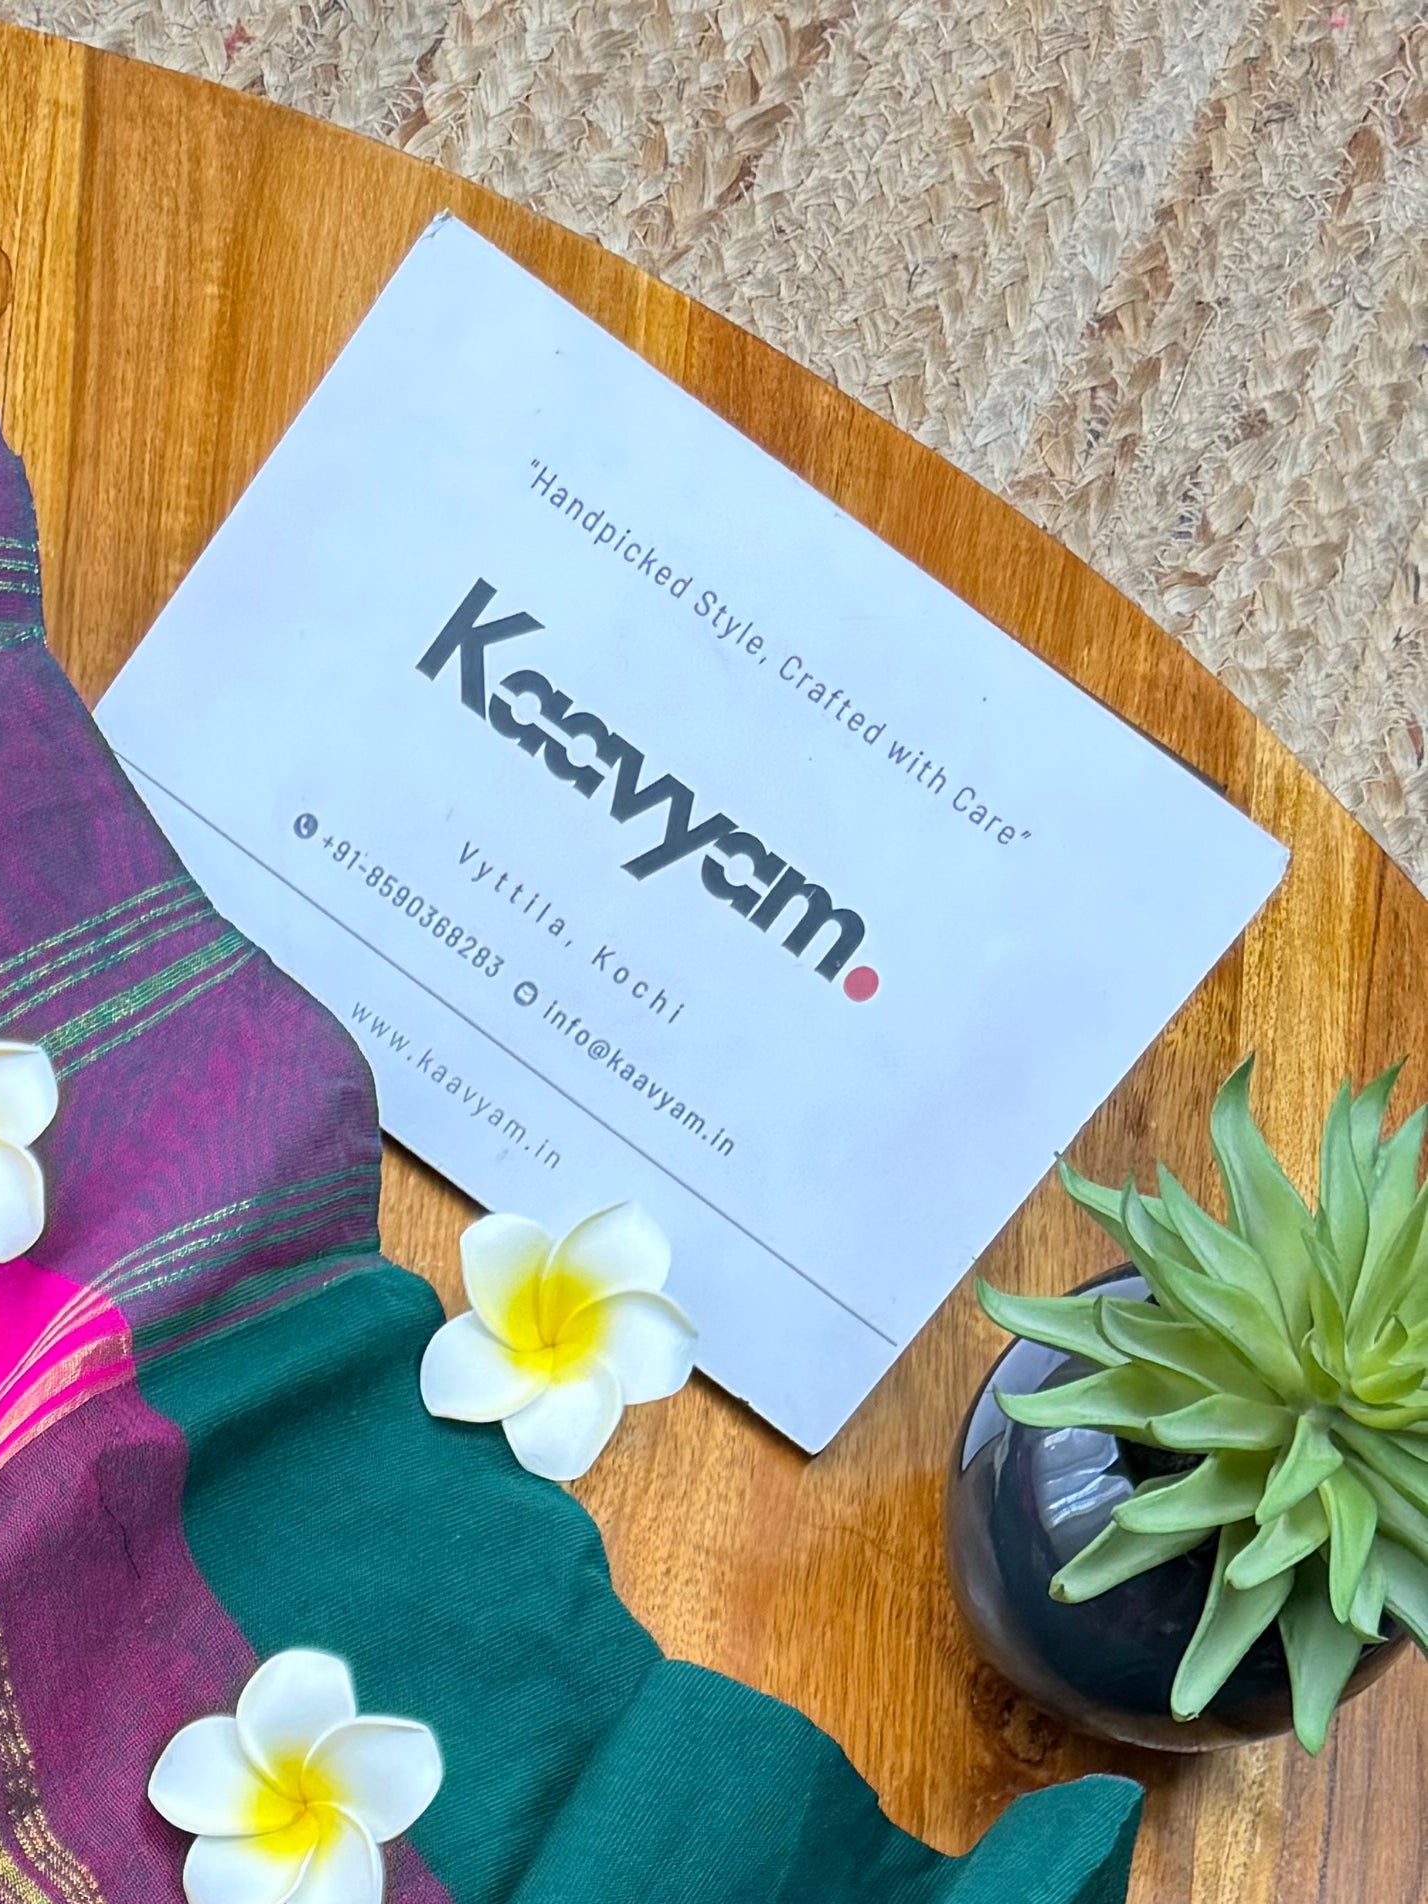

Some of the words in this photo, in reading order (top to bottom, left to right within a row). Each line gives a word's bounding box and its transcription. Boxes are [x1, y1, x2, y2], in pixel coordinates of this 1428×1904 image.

[694, 590, 767, 665] Style,
[779, 655, 887, 745] Crafted
[887, 740, 947, 794] with
[322, 835, 505, 978] +91-8590368283
[542, 1000, 735, 1156] info@kaavyam.in
[459, 840, 572, 948] Vyttila,
[591, 945, 685, 1024] Kochi
[351, 1002, 561, 1169] www.kaavyam.in
